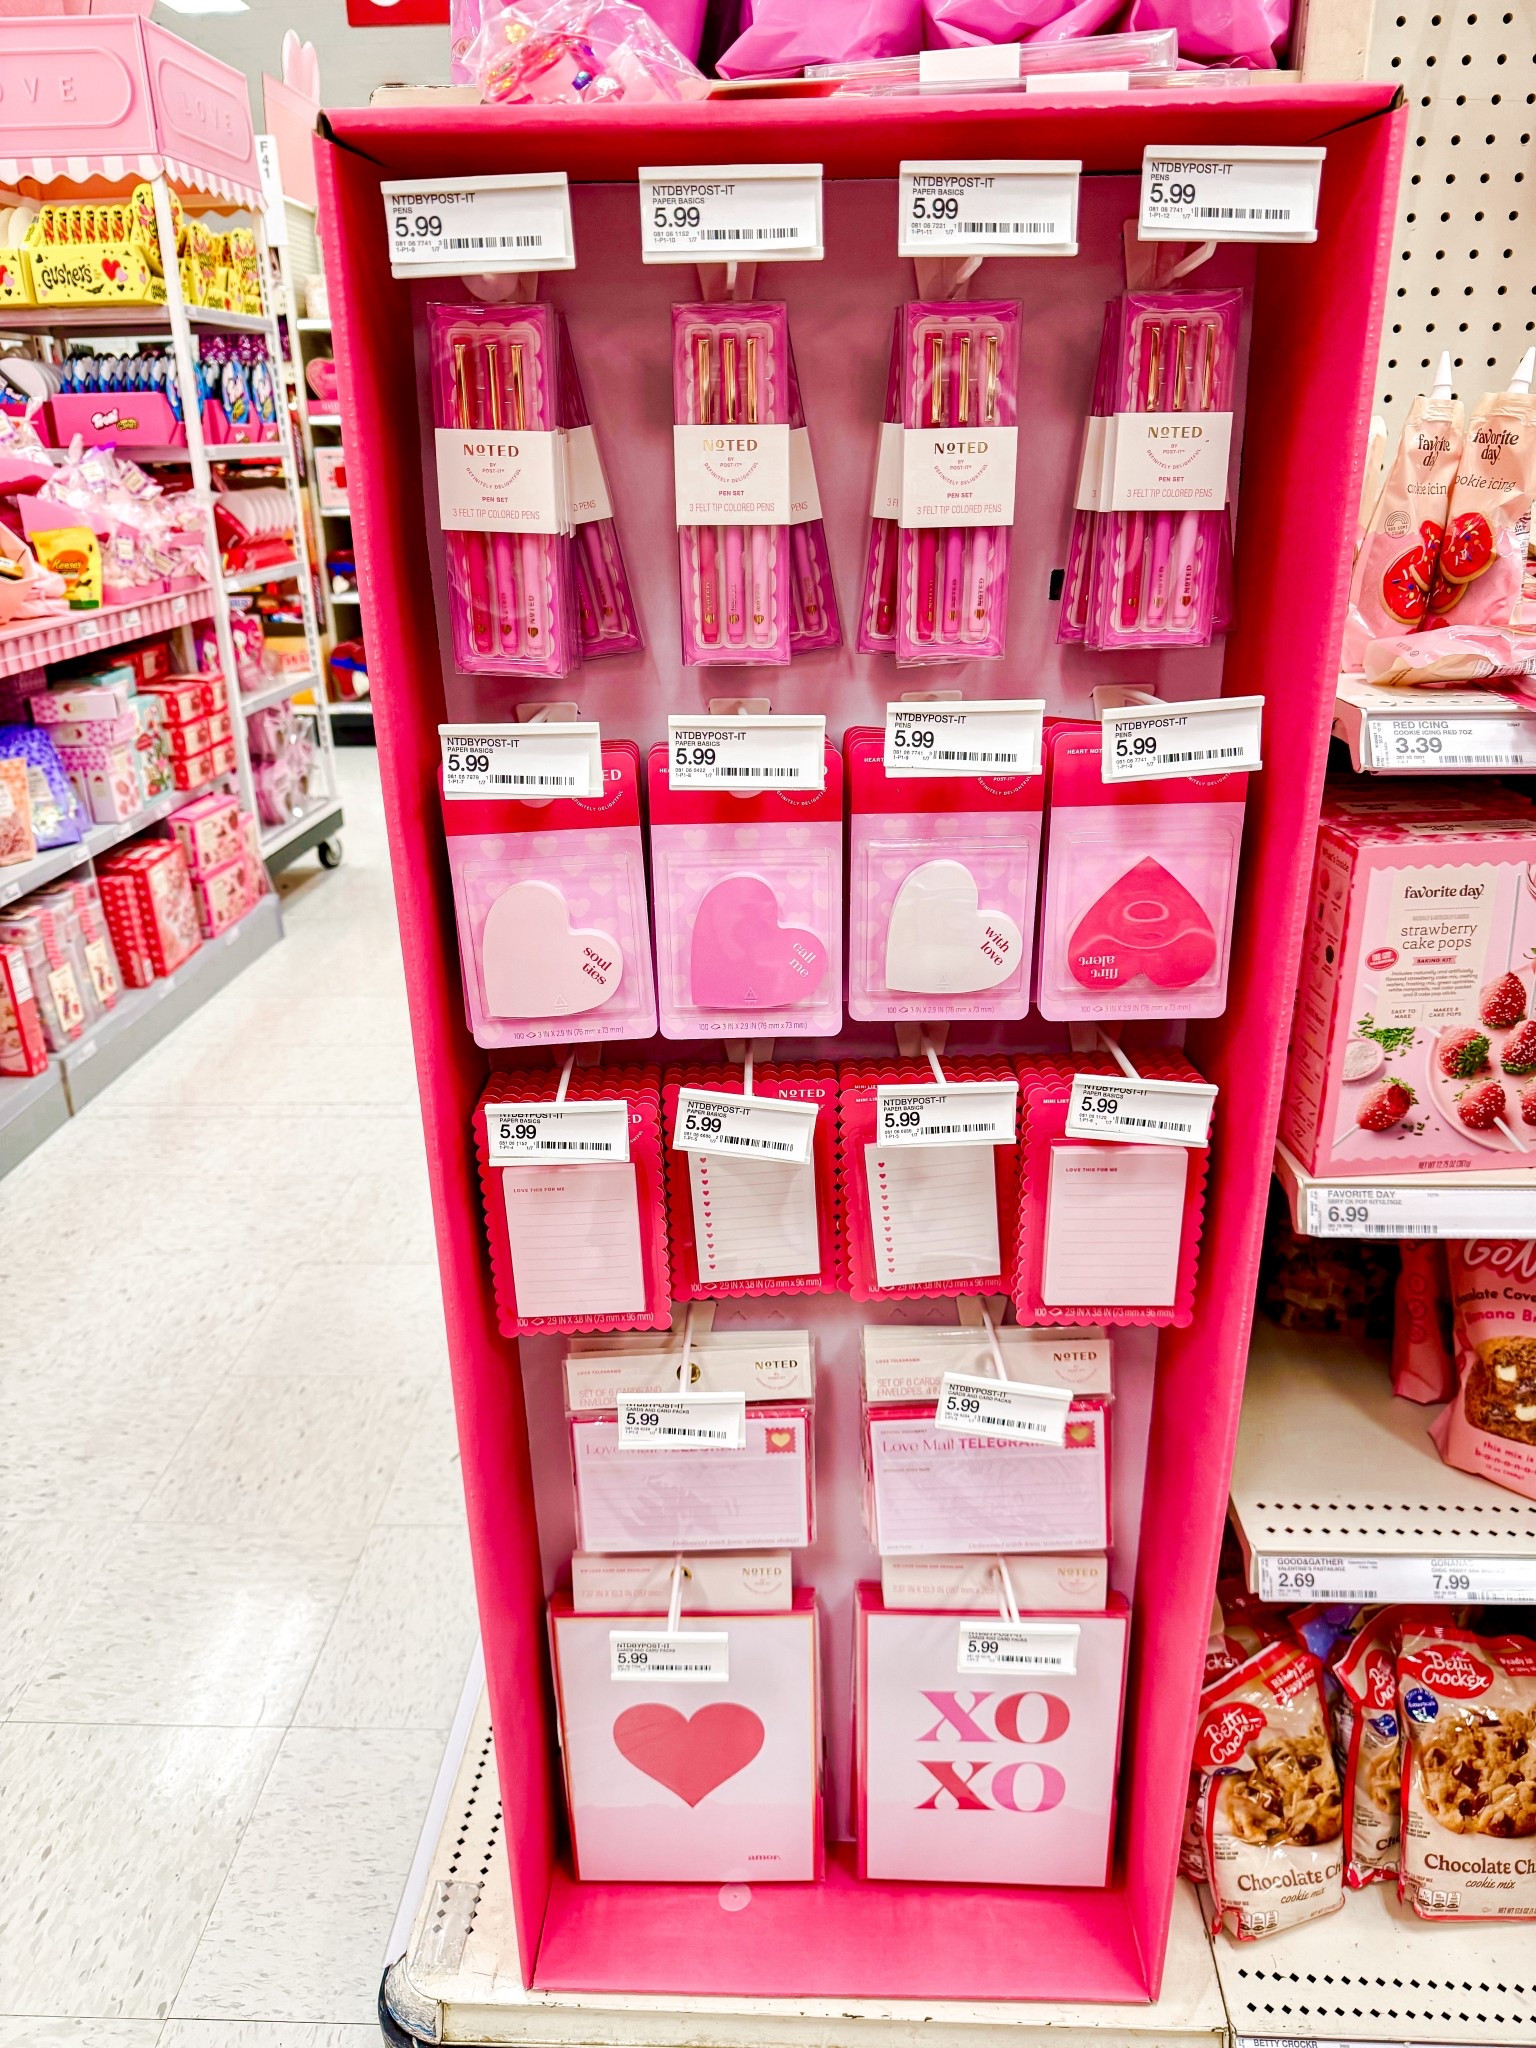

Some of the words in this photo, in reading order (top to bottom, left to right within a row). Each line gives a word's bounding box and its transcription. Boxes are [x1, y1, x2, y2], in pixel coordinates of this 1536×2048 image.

[1151, 162, 1233, 175] NTDBYPOST-IT
[913, 176, 995, 188] NTDBYPOST-IT
[652, 184, 735, 197] NTDBYPOST-IT
[912, 188, 936, 196] PAPER
[937, 188, 964, 196] BASICS
[1150, 183, 1196, 204] 5.99
[391, 192, 476, 205] NTDBYPOST-IT
[652, 197, 677, 205] PAPER
[678, 197, 705, 205] BASICS
[912, 198, 959, 219] 5.99
[653, 207, 701, 228] 5.99
[395, 215, 442, 237] 5.99
[1473, 428, 1519, 446] favorite
[1481, 445, 1501, 465] day
[1487, 477, 1517, 493] icing
[1126, 489, 1131, 498] 3
[1133, 489, 1149, 498] FELT
[1150, 489, 1160, 498] TIP
[1162, 488, 1193, 498] COLORED
[1194, 488, 1213, 498] PENS
[452, 509, 457, 517] 3
[458, 509, 474, 517] FELT
[476, 509, 486, 518] TIP
[488, 510, 519, 519] COLORED
[521, 511, 540, 520] PENS
[688, 504, 694, 512] 3
[695, 504, 712, 512] FELT
[713, 504, 723, 512] TIP
[724, 503, 755, 512] COLORED
[757, 502, 775, 512] PENS
[916, 506, 921, 515] 3
[922, 506, 939, 515] FELT
[940, 505, 949, 514] TIP
[951, 504, 982, 514] COLORED
[984, 503, 1002, 513] PENS
[895, 713, 967, 724] NTDBYPOST-IT
[1115, 717, 1188, 732] NTDBYPOST-IT
[1393, 721, 1415, 729] RED
[1418, 721, 1449, 729] ICING
[447, 738, 520, 749] NTDBYPOST-IT
[675, 731, 747, 741] NTDBYPOST-IT
[894, 730, 935, 748] 5.99
[1116, 738, 1157, 757] 5.99
[1395, 737, 1442, 754] 3.39
[447, 754, 490, 773] 5.99
[675, 748, 716, 766] 5.99
[1404, 885, 1457, 899] favorite
[1459, 883, 1485, 900] day
[1400, 922, 1478, 937] strawberry
[984, 925, 1010, 953] with
[1402, 938, 1435, 950] cake
[1437, 939, 1472, 952] pops
[582, 945, 613, 971] soul
[791, 941, 817, 964] call
[980, 942, 1003, 966] love
[788, 957, 810, 978] me
[1078, 955, 1115, 966] alert
[582, 963, 606, 985] ties
[1090, 967, 1119, 979] flirt
[687, 1101, 751, 1116] NTDBYPOST-IT
[883, 1096, 947, 1106] NTDBYPOST-IT
[1081, 1096, 1118, 1114] 5.99
[685, 1115, 722, 1132] 5.99
[884, 1112, 921, 1128] 5.99
[500, 1124, 537, 1140] 5.99
[1327, 1190, 1373, 1199] FAVORITE
[1376, 1190, 1396, 1198] DAY
[1328, 1206, 1369, 1222] 6.99
[949, 1383, 1008, 1398] NTDBYPOST-IT
[946, 1396, 980, 1413] 5.99
[626, 1412, 659, 1426] 5.99
[882, 1440, 919, 1453] Love
[923, 1437, 955, 1451] Mail
[1277, 1558, 1344, 1566] GOOD&GATHER
[1278, 1573, 1315, 1588] 2.69
[1432, 1575, 1470, 1590] 7.99
[968, 1640, 999, 1654] 5.99
[617, 1652, 648, 1664] 5.99
[1424, 1650, 1474, 1676] Betty
[915, 1689, 1070, 1744] XO
[914, 1760, 1066, 1812] XO
[1424, 1854, 1512, 1875] Chocolate
[1237, 1869, 1322, 1893] Chocolate
[1465, 1877, 1494, 1889] cookie
[1496, 1879, 1516, 1890] mix
[1280, 1890, 1309, 1904] cookie
[1253, 2038, 1280, 2047] BETTY
